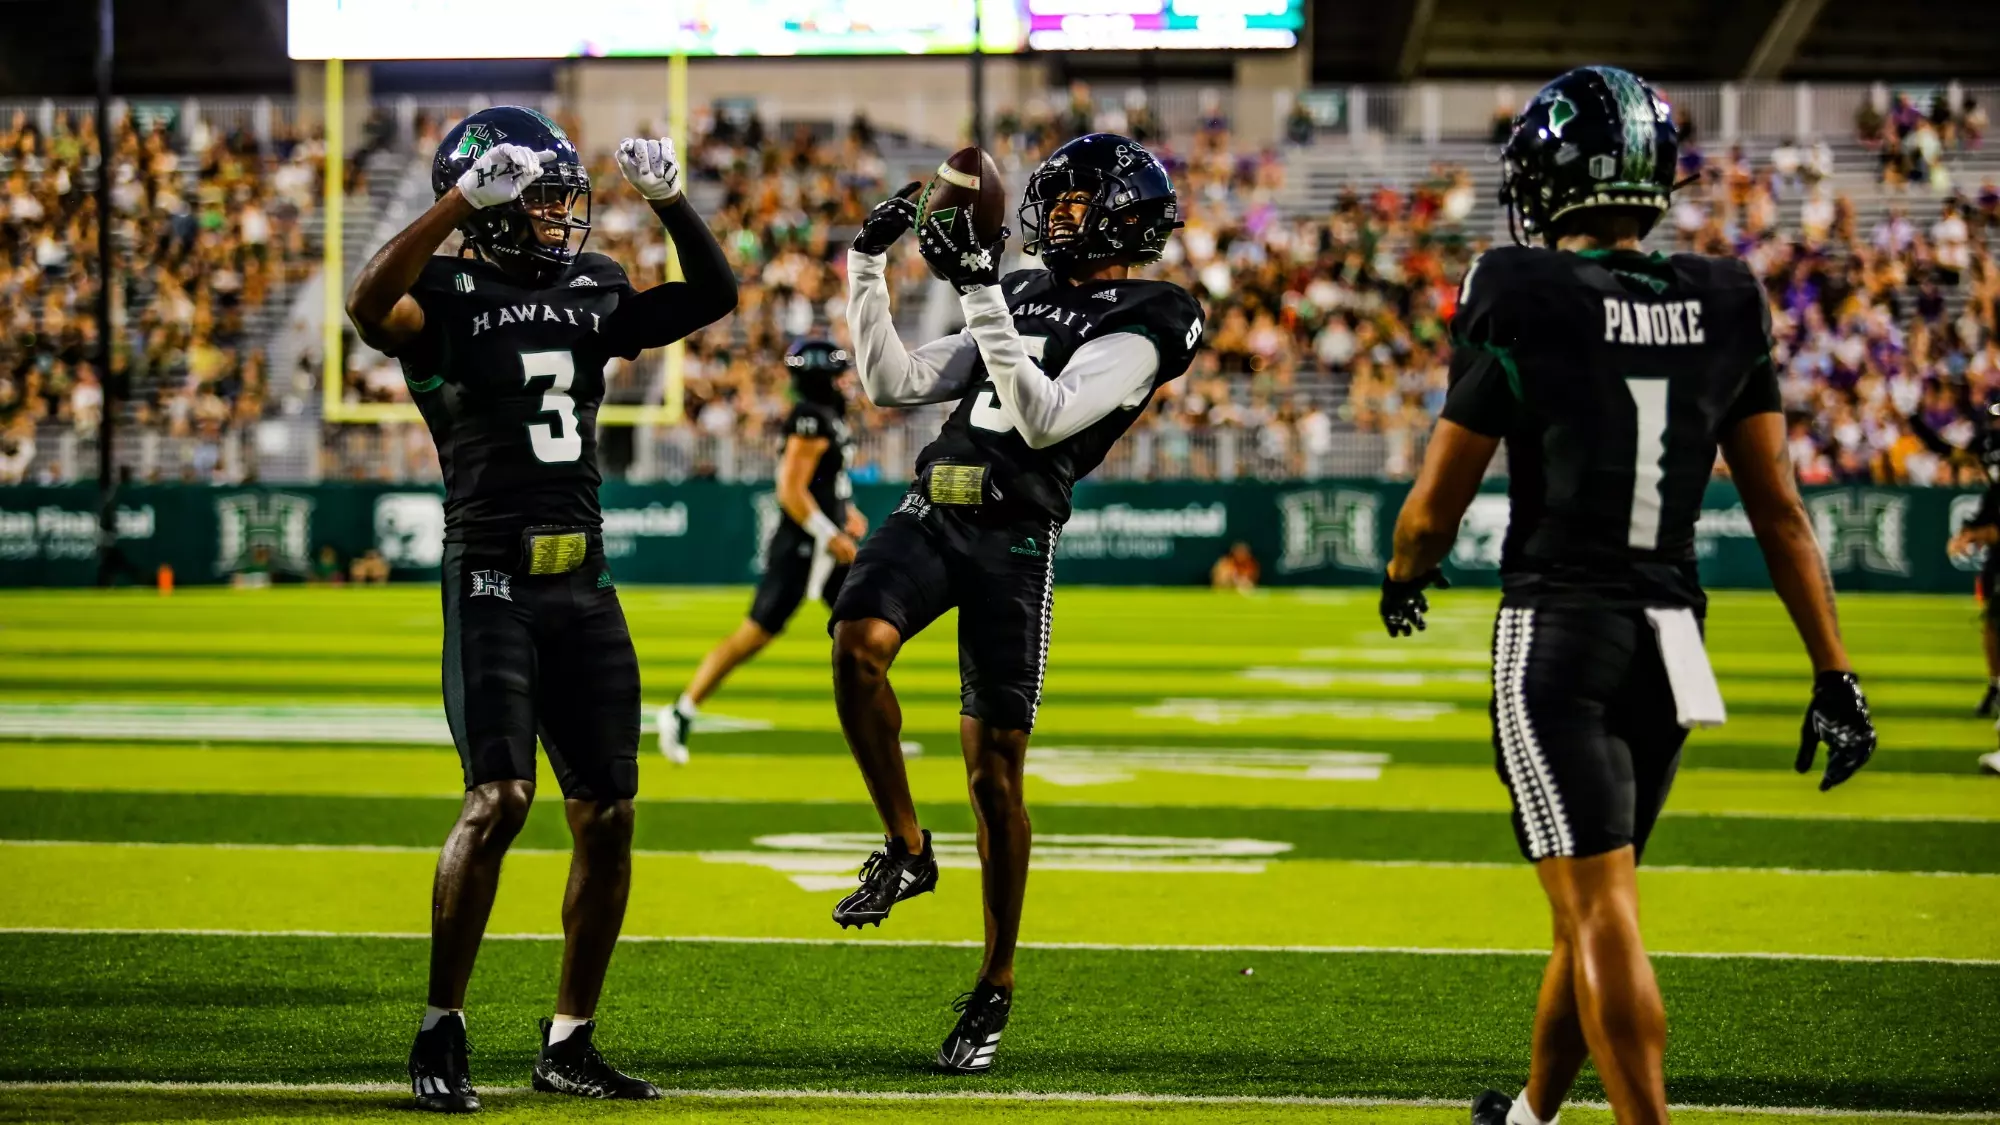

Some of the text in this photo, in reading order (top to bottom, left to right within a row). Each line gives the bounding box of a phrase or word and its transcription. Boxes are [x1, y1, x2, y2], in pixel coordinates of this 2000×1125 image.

[1011, 302, 1093, 338] AWAI'I
[1185, 316, 1203, 350] 5
[1603, 297, 1705, 345] PANOKE
[518, 350, 582, 463] 3
[1624, 377, 1669, 550] 1
